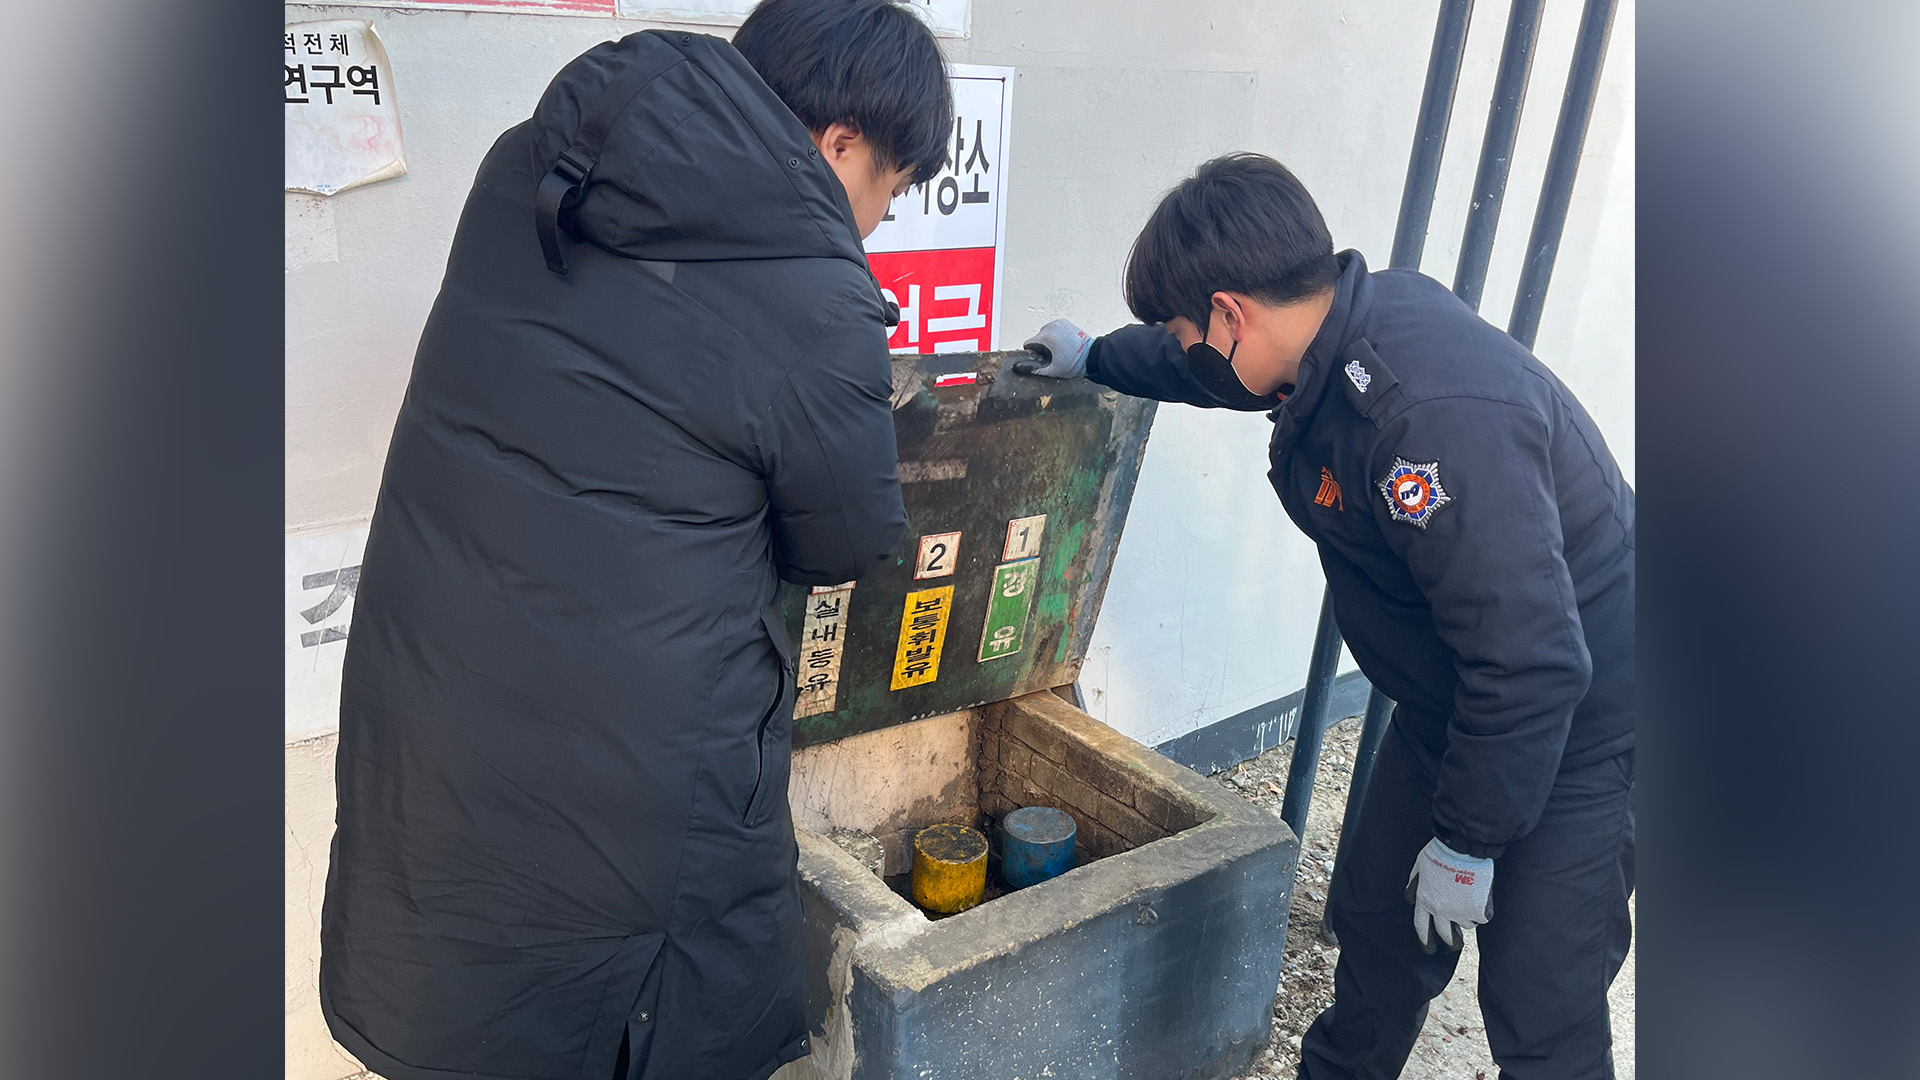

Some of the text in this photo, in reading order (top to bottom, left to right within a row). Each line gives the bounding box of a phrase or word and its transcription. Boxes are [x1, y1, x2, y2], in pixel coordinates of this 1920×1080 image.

[1019, 526, 1030, 552] 1
[926, 542, 947, 572] 2
[804, 597, 841, 693] 실내등유
[901, 597, 943, 678] 보통휘발유
[1454, 873, 1475, 886] 3M
